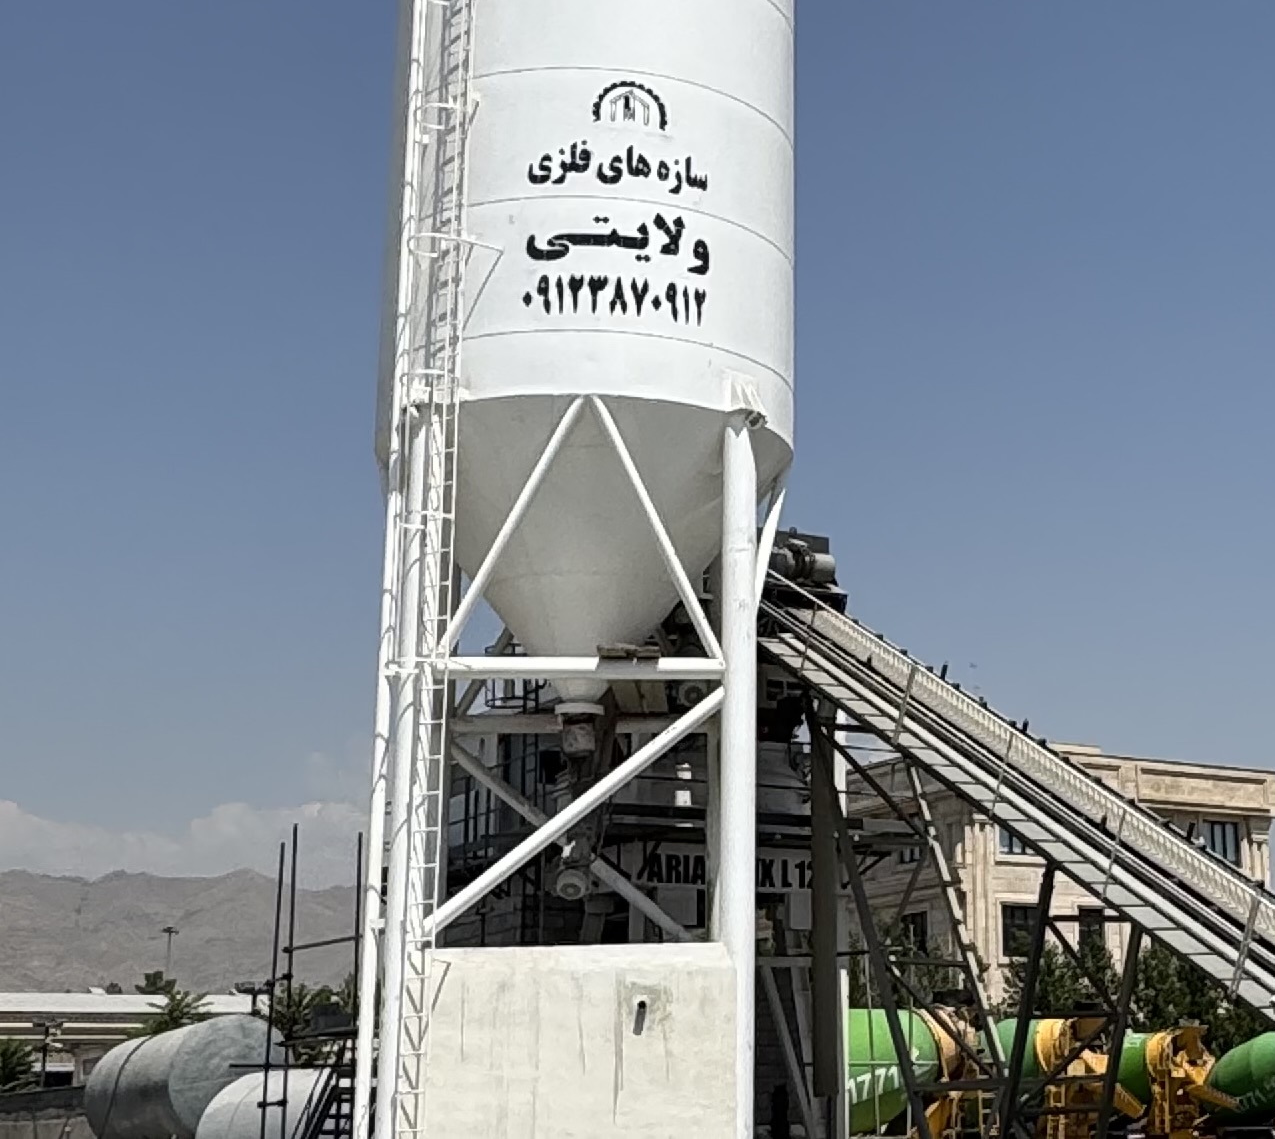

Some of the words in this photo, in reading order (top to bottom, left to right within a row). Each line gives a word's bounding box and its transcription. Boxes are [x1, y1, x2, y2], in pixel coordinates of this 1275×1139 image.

[527, 139, 592, 185] فلزی
[596, 144, 651, 185] های
[657, 155, 708, 195] سازه
[526, 212, 710, 275] ولایتی
[522, 273, 706, 327] ۰۹۱۲۳۸۷۰۹۱۲
[647, 852, 706, 884] ARIA
